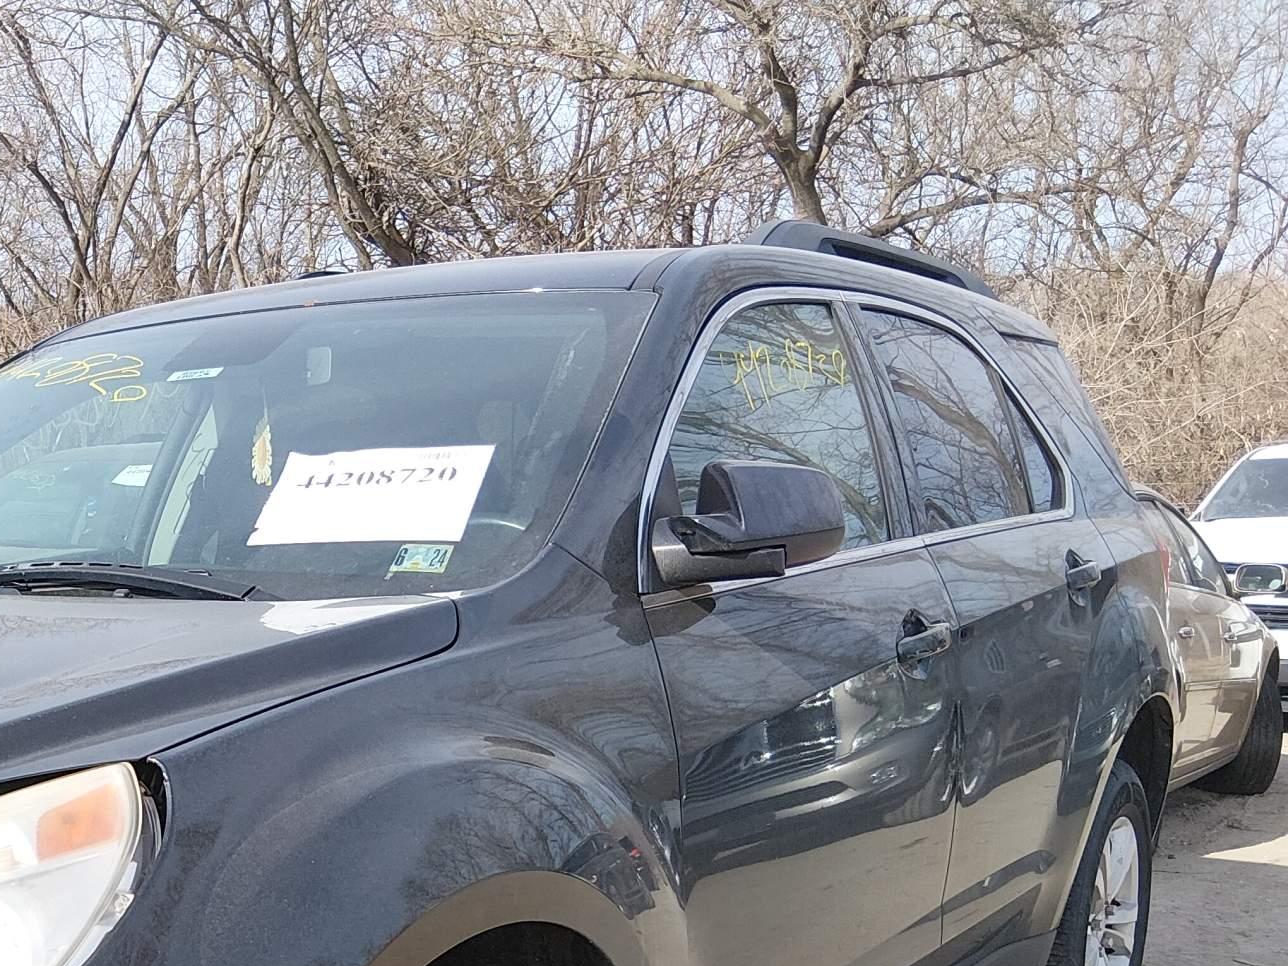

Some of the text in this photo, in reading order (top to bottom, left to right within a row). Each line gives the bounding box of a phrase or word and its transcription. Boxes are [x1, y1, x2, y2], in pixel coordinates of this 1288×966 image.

[295, 465, 458, 489] 44208720
[394, 547, 448, 568] 6 24
